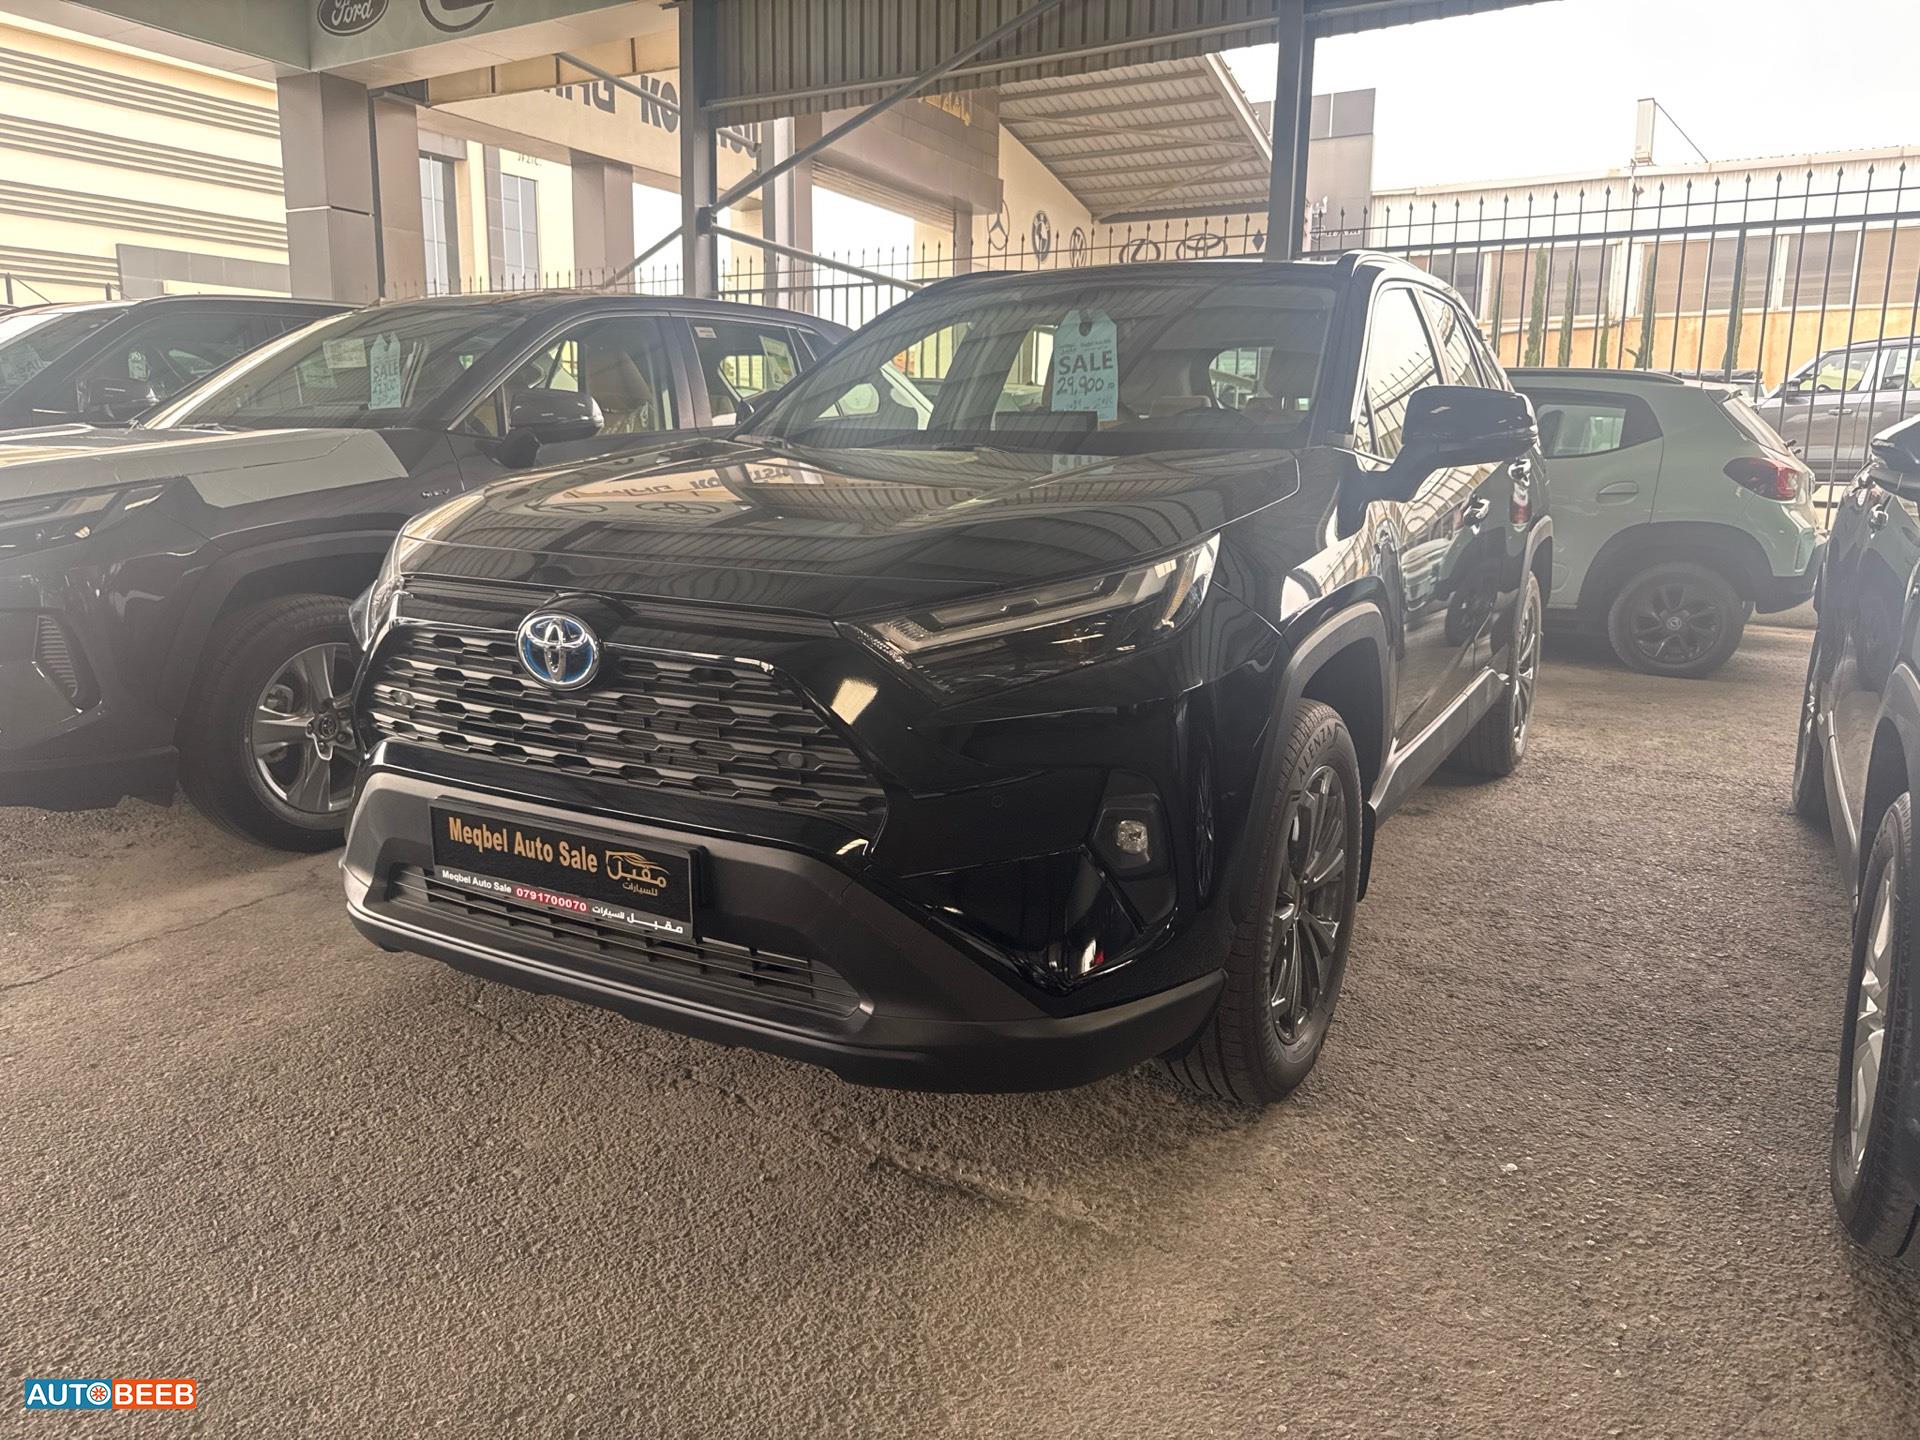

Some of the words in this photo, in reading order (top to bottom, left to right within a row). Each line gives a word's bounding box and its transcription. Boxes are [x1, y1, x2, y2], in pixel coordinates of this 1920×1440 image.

[331, 0, 374, 26] Ford
[373, 361, 398, 379] SALE
[1059, 350, 1114, 375] SALE
[1056, 376, 1104, 396] 29,900
[448, 816, 508, 854] Meqbel
[513, 831, 553, 864] Auto
[559, 846, 599, 874] Sale
[442, 869, 471, 885] Meqbel
[472, 877, 492, 889] Auto
[493, 882, 512, 894] Sale
[516, 888, 587, 912] 0791700070
